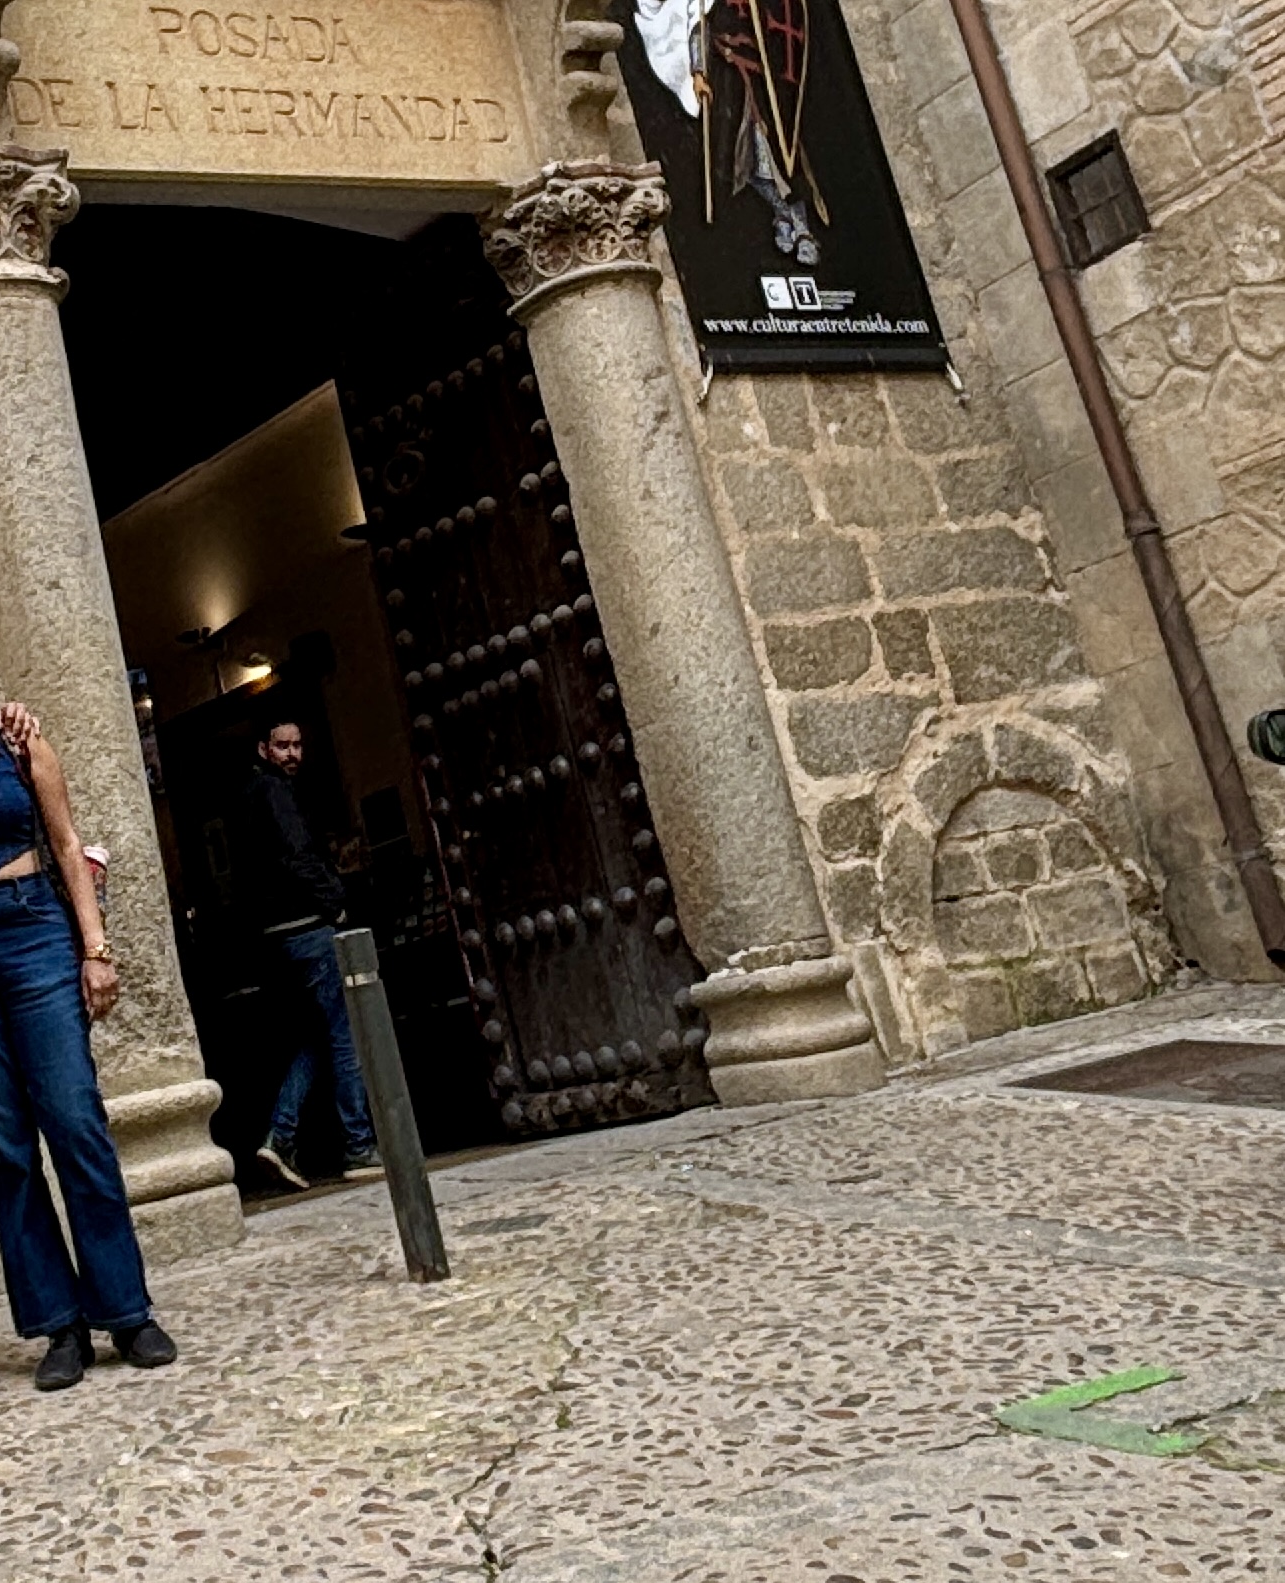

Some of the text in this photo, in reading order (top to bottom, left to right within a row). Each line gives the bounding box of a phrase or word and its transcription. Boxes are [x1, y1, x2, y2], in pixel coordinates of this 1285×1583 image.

[148, 6, 363, 64] POSADA
[8, 77, 509, 143] DE LA HERMANDAD
